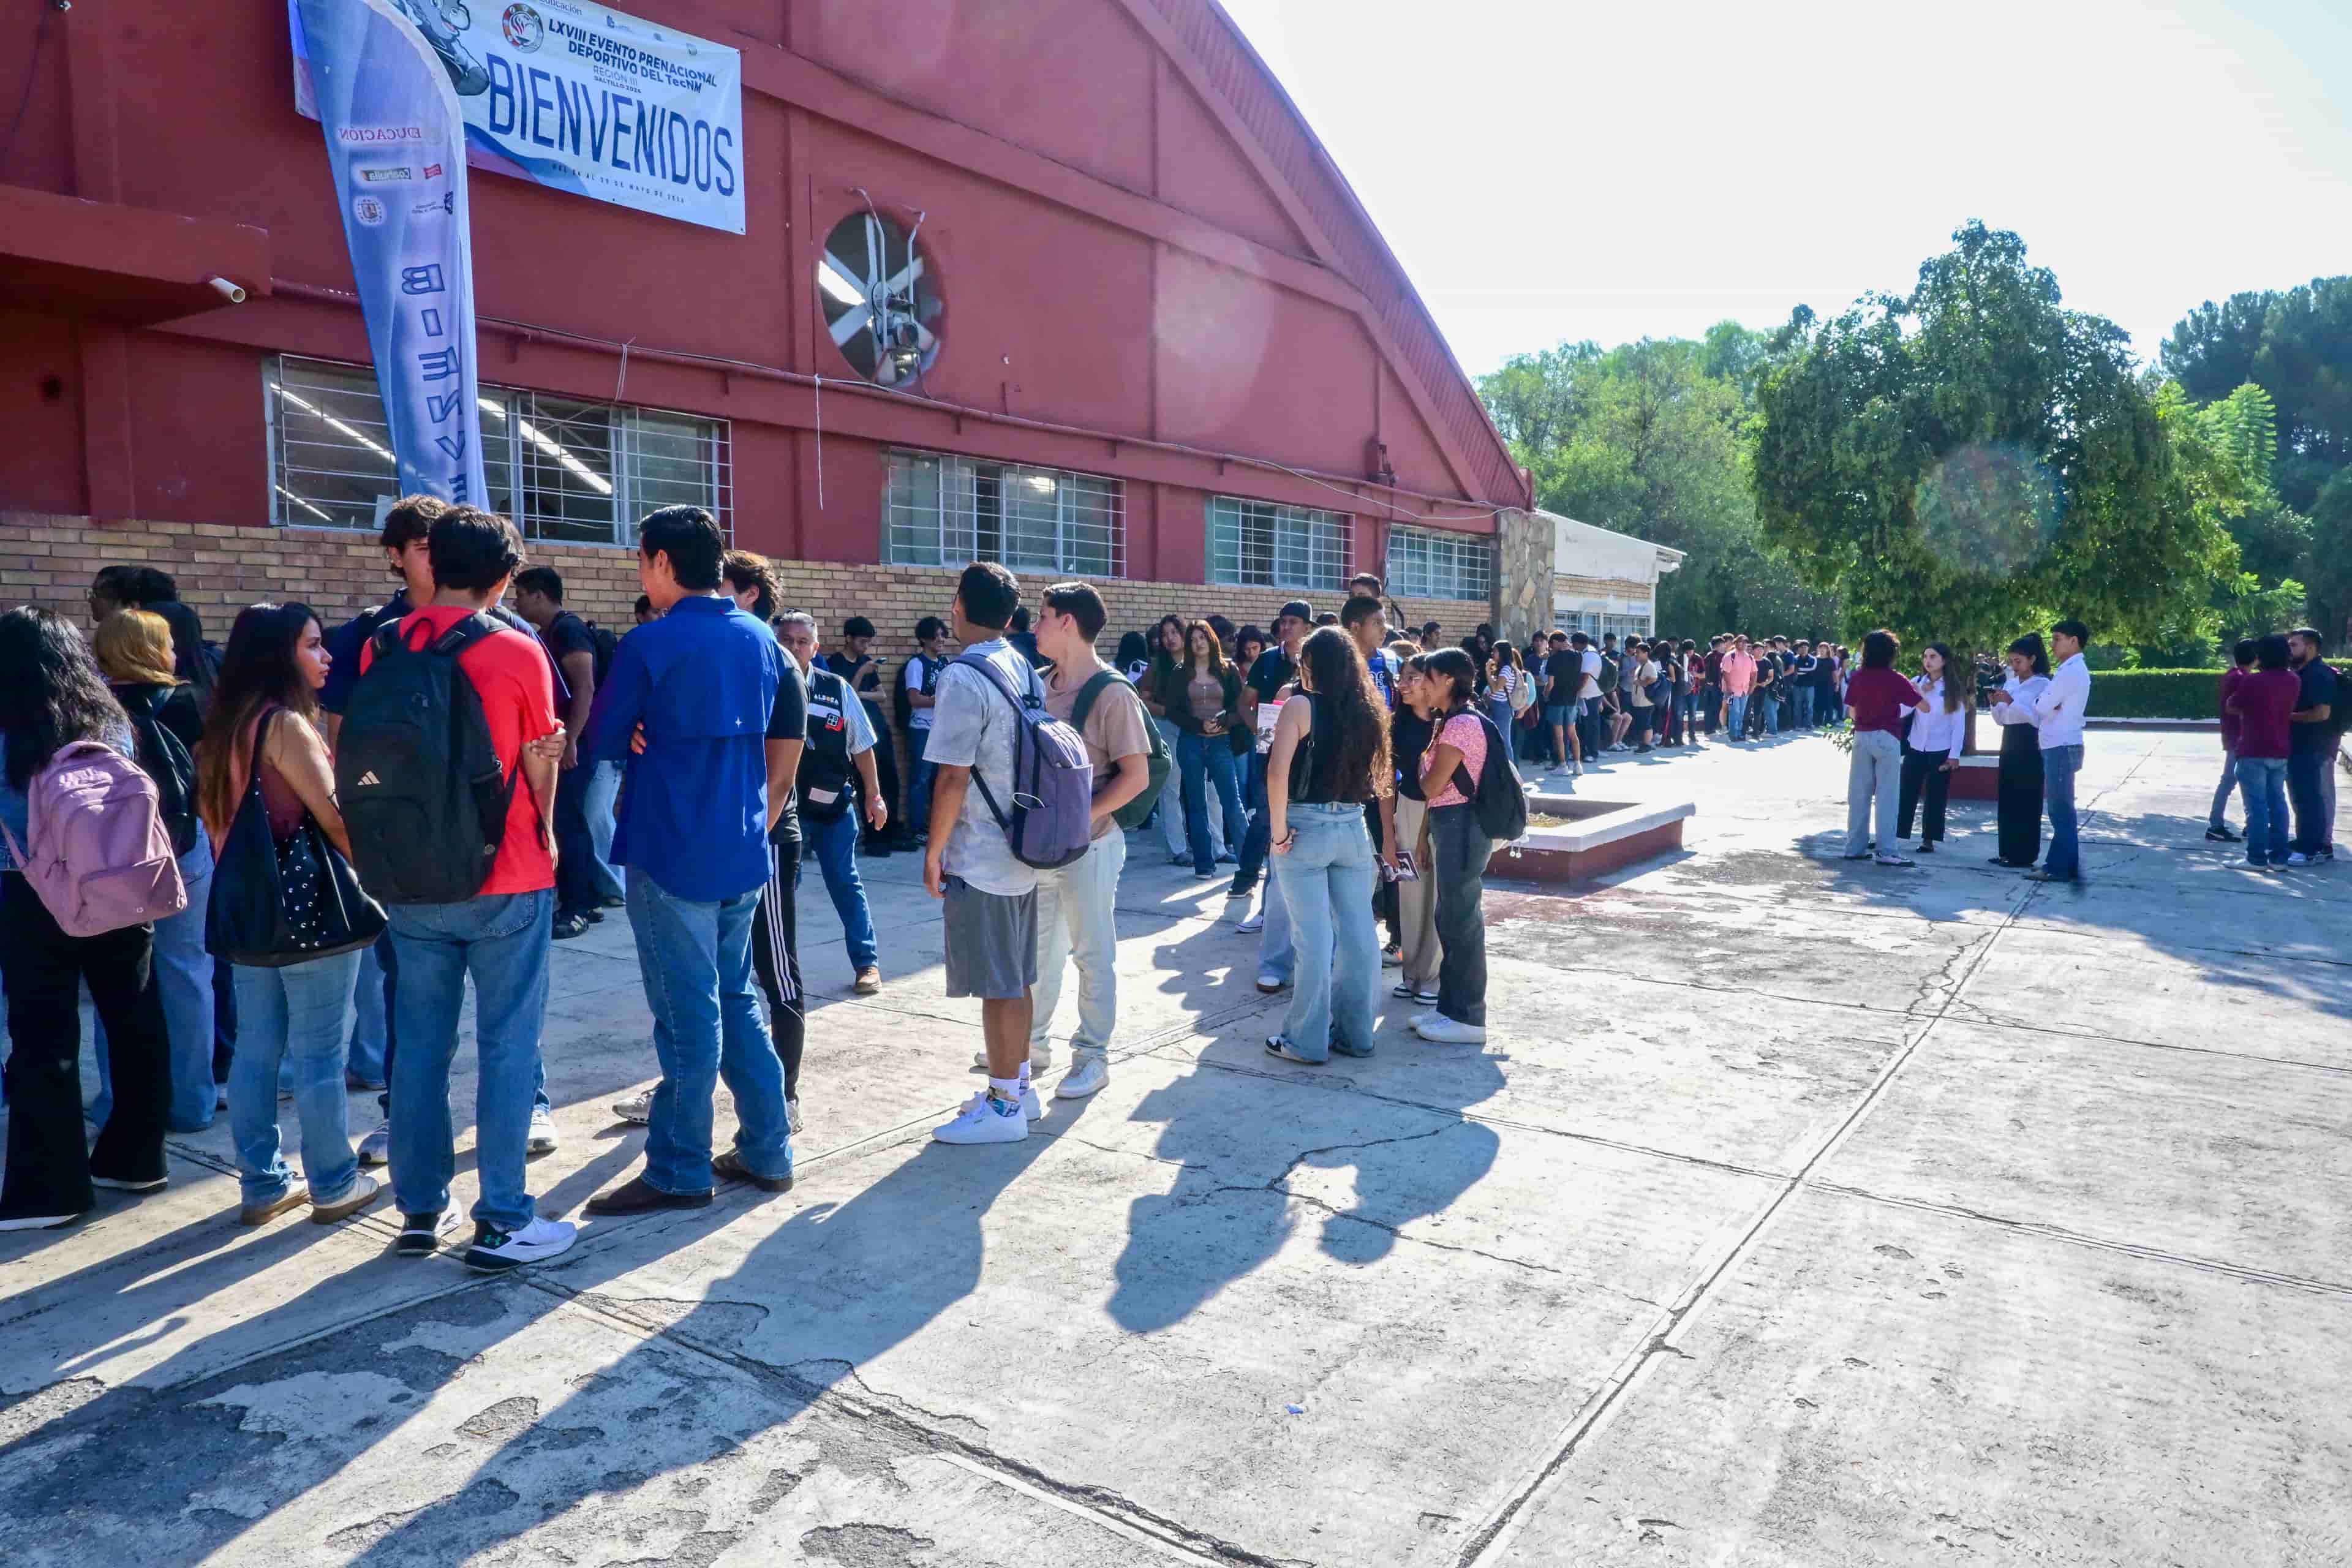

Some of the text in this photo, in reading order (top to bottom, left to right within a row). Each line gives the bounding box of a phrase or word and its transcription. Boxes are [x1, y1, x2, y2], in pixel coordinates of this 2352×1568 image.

[548, 18, 586, 43] LXVIII
[589, 33, 636, 60] EVENTO
[639, 51, 717, 87] PRENACIONAL
[568, 40, 703, 93] DEPORTIVO DEL TecNM
[594, 75, 626, 89] SALTILLO
[486, 52, 735, 197] BIENVENIDOS
